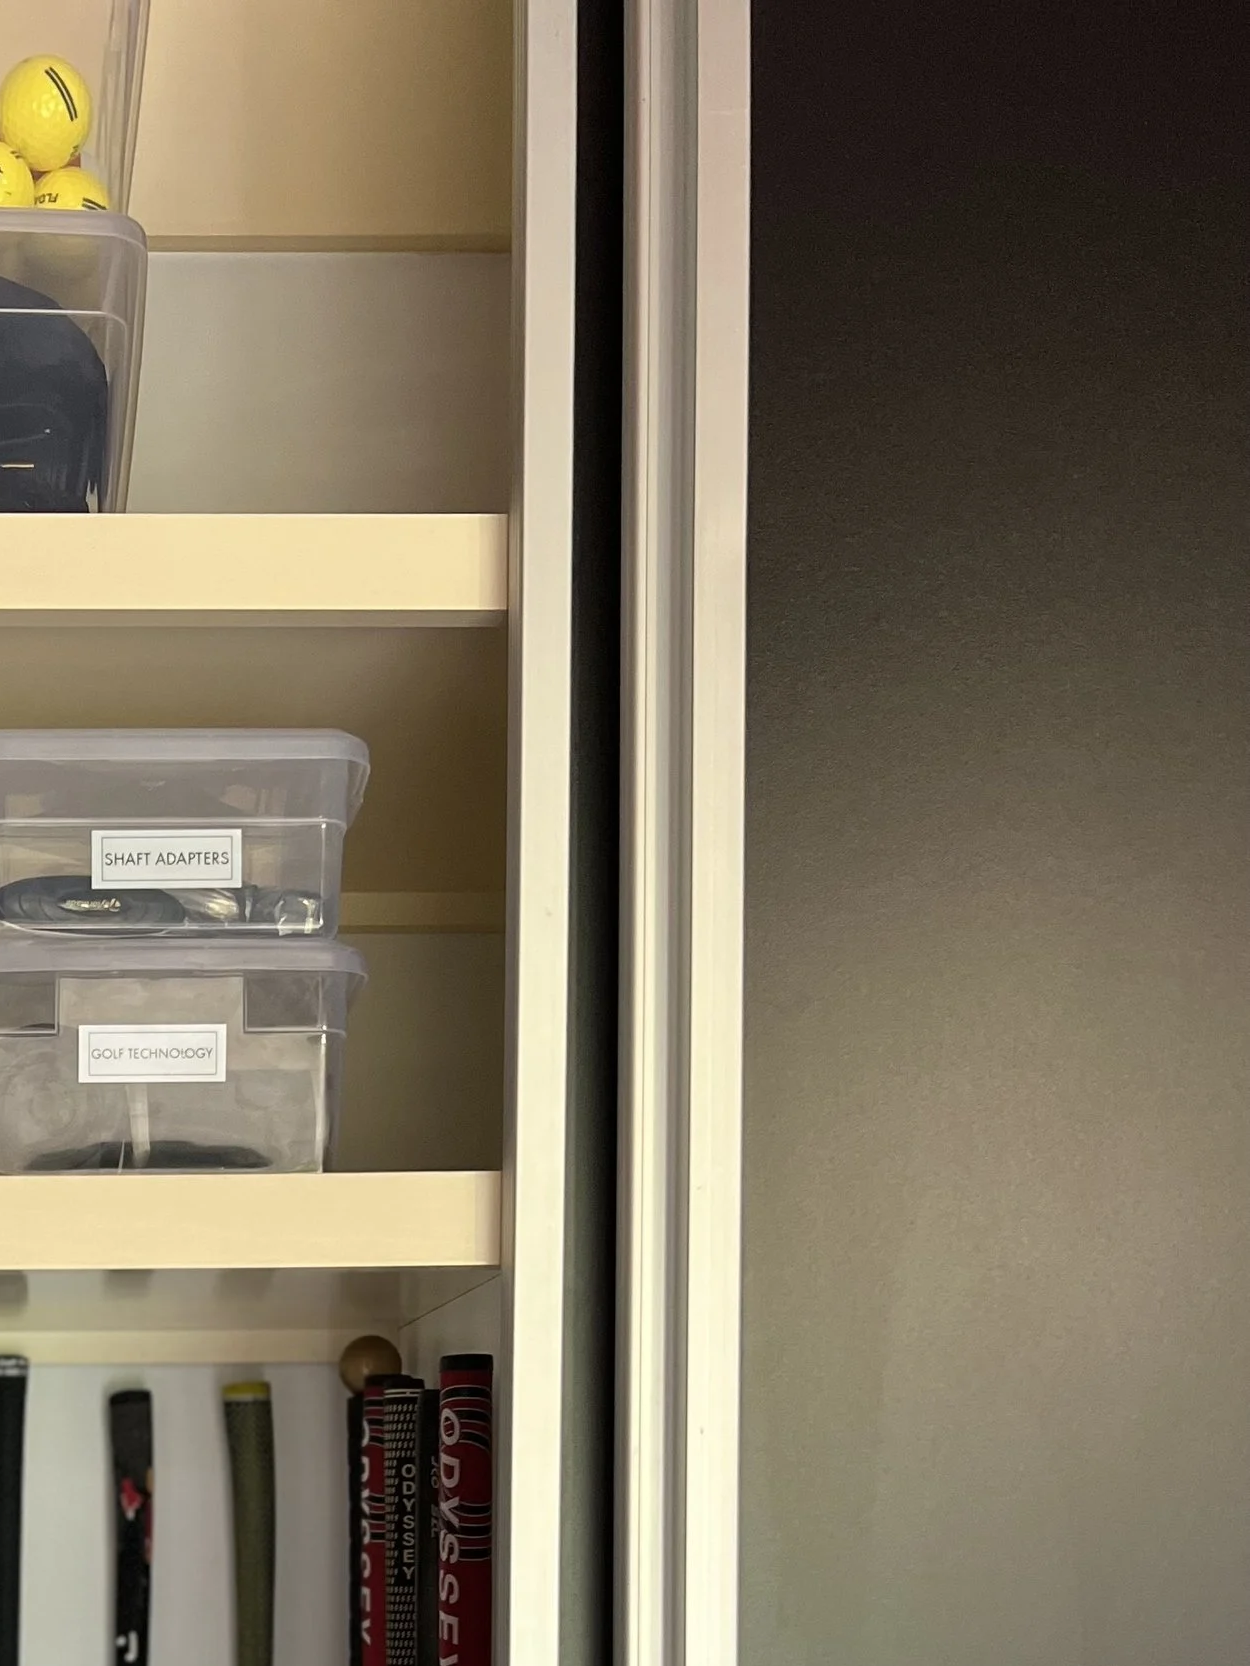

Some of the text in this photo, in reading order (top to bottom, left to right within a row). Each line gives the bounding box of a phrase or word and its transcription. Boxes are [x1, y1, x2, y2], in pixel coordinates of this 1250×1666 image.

[104, 851, 230, 867] SHAFT ADAPTERS
[90, 1046, 214, 1060] GOLF TECHNOLOGY
[401, 1462, 416, 1581] ODYSSEY
